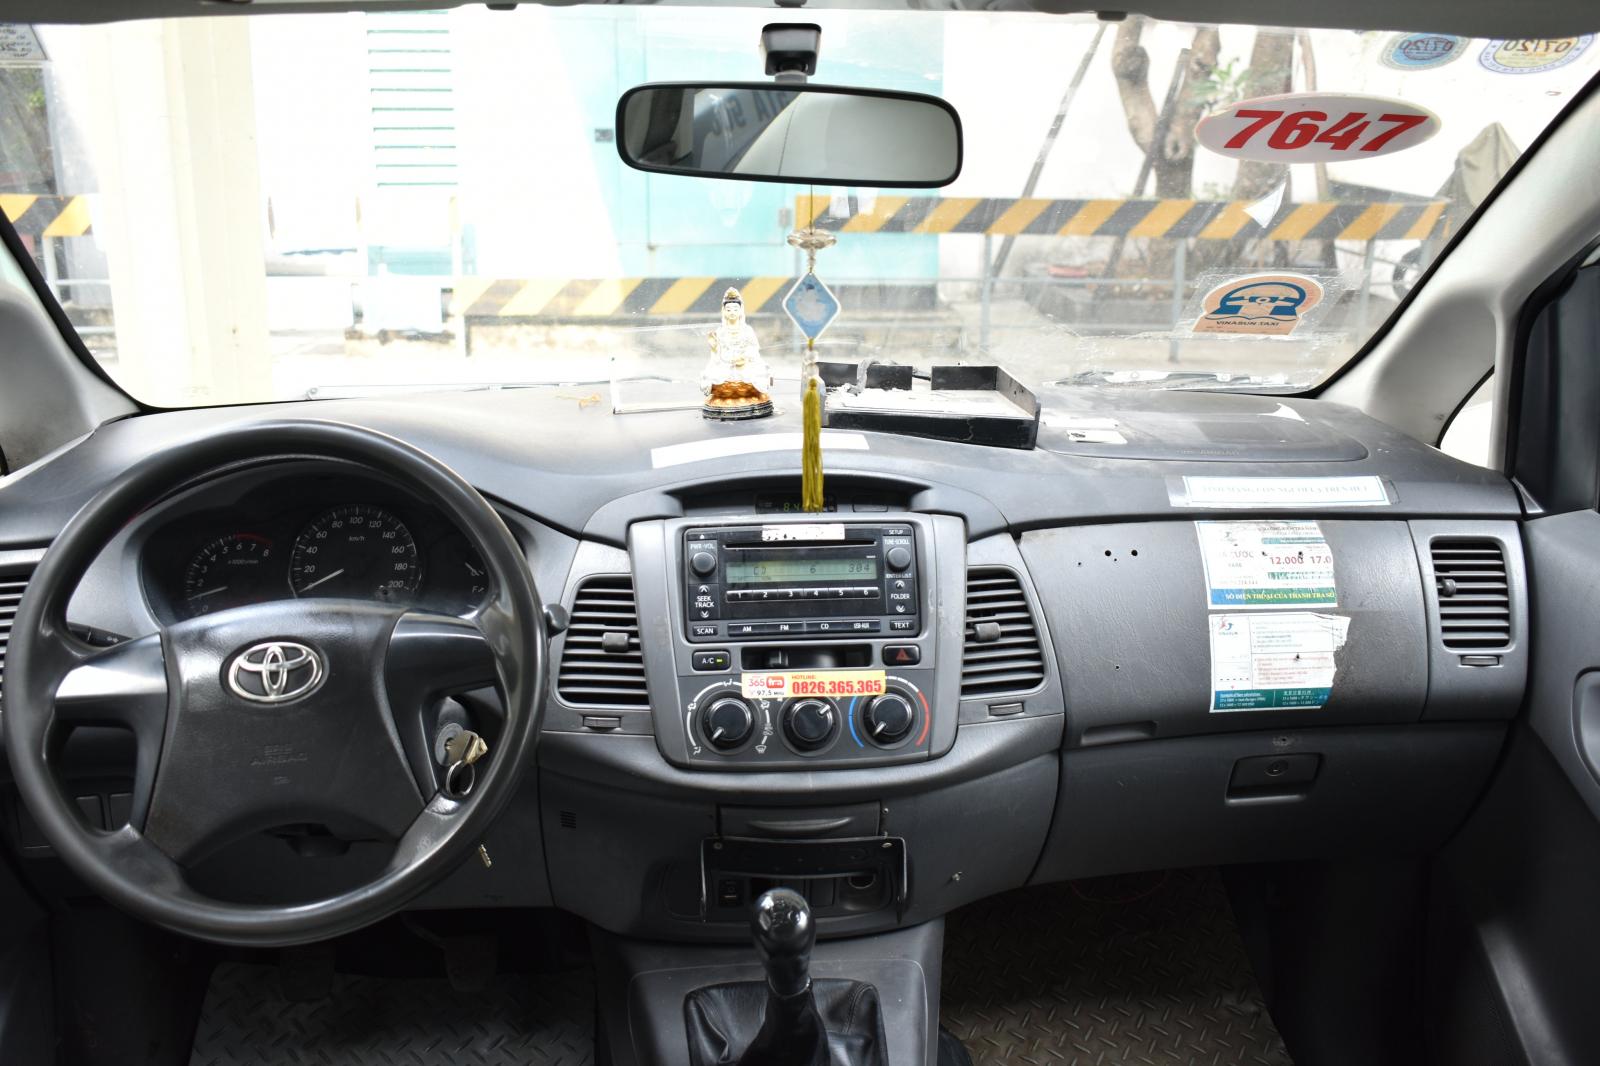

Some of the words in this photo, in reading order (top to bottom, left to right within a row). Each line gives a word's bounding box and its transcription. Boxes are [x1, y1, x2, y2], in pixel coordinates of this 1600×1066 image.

[1223, 109, 1431, 152] 7647
[1216, 319, 1257, 327] VINASUN
[331, 520, 343, 528] 80
[349, 516, 364, 524] 100
[368, 520, 382, 528] 120
[316, 531, 327, 539] 60
[382, 531, 396, 539] 140
[250, 543, 256, 551] 7
[306, 546, 318, 554] 40
[391, 546, 405, 554] 160
[263, 549, 269, 557] 8
[1269, 555, 1304, 565] 12.000
[304, 565, 315, 573] 20
[394, 562, 408, 571] 180
[388, 580, 404, 588] 200
[748, 678, 765, 687] 365
[792, 680, 882, 695] 0826.365.365
